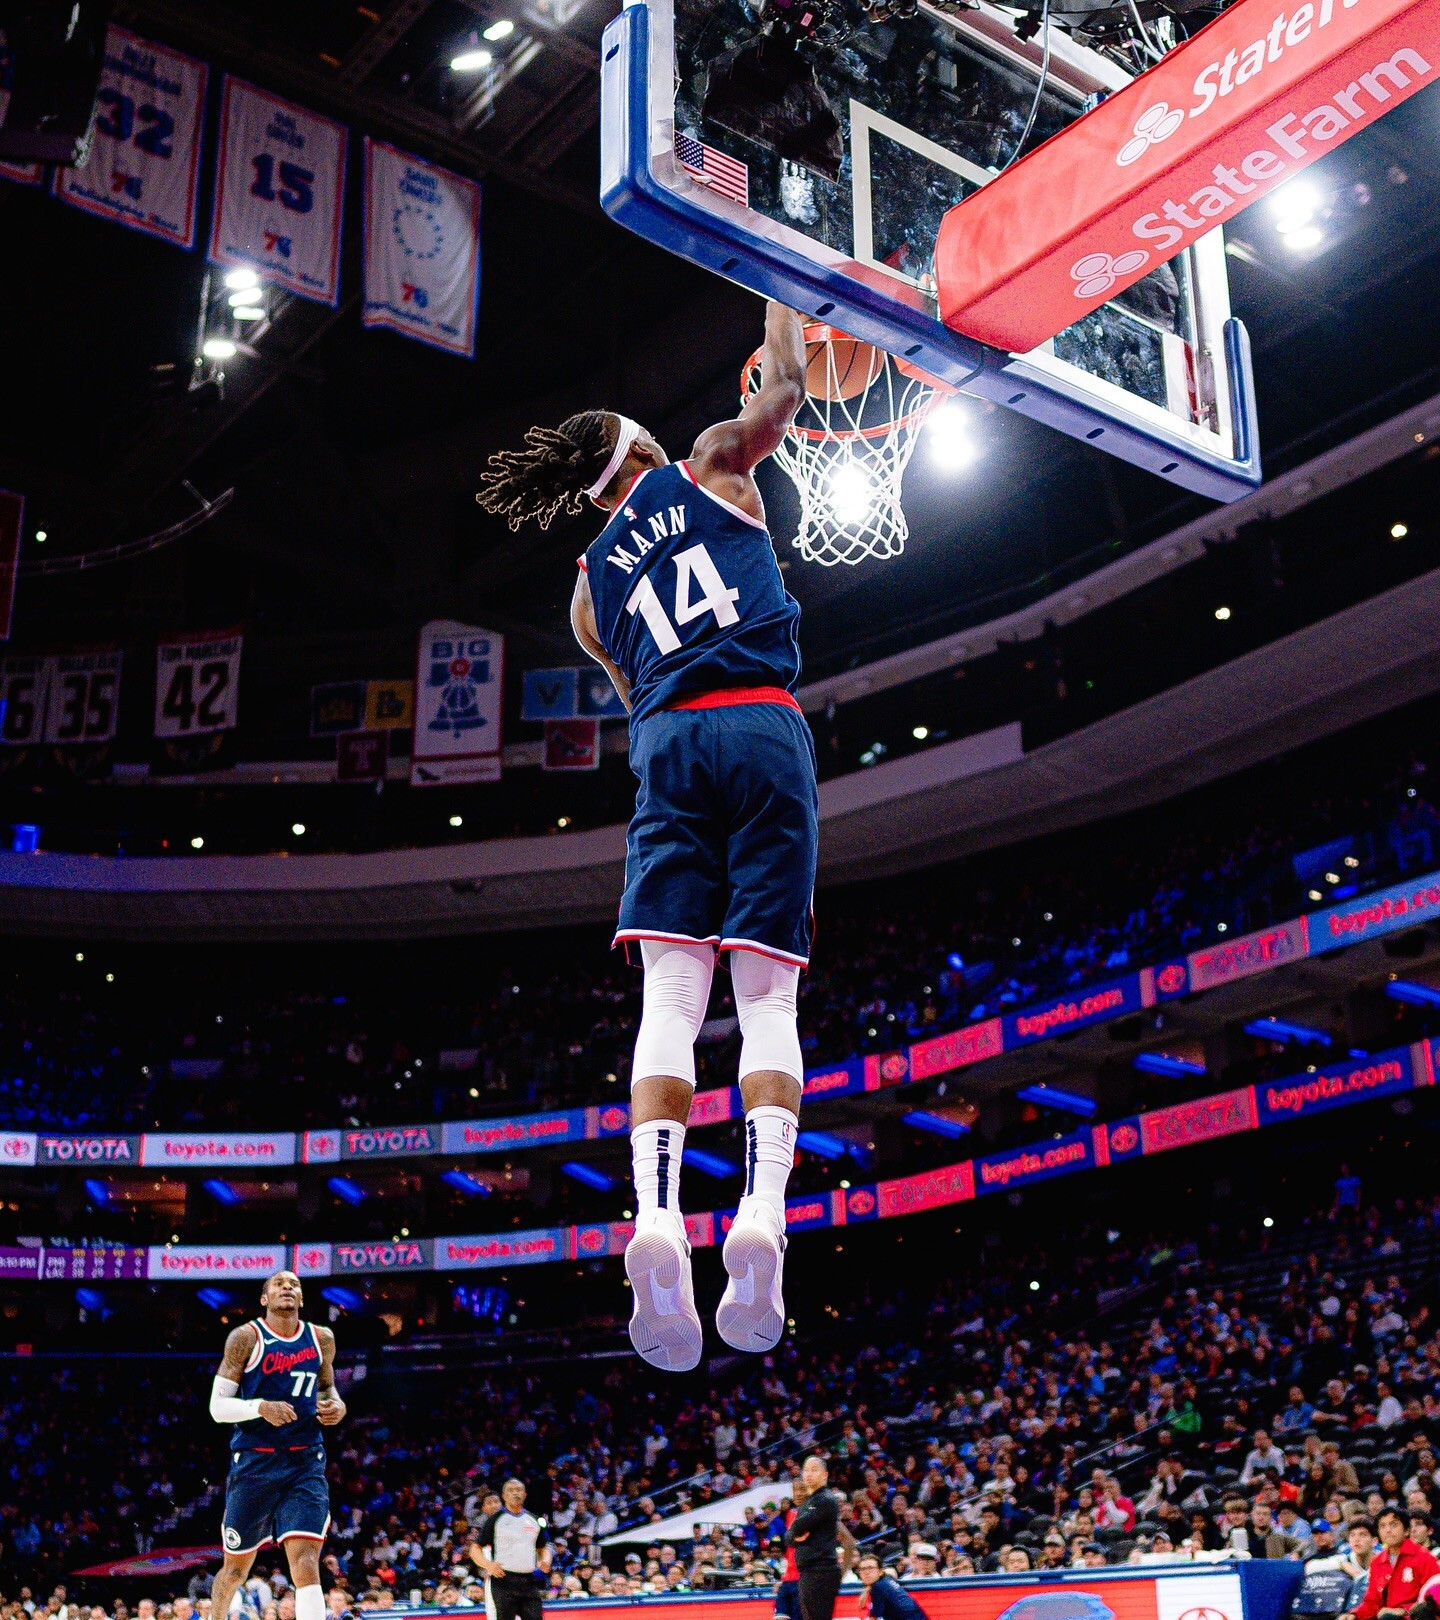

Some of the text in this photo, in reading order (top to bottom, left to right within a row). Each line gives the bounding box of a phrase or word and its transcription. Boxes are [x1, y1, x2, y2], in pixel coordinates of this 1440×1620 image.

[97, 87, 175, 158] 32
[112, 171, 143, 199] 76
[249, 153, 315, 214] 15
[263, 230, 292, 257] 76
[401, 282, 429, 308] 76
[606, 505, 686, 574] MANN
[625, 542, 740, 655] 14
[431, 640, 490, 659] BIG
[57, 674, 116, 738] 35
[162, 661, 230, 730] 42
[1016, 988, 1123, 1036] toyota.com
[1266, 1061, 1402, 1112] toyota.com
[43, 1119, 568, 1160] TOYOTA toyota.com TOYOTA toyota.com
[981, 1142, 1085, 1185] toyota.com
[161, 1252, 276, 1273] toyota.com
[337, 1244, 424, 1267] TOYOTA
[447, 1237, 554, 1263] toyota.com
[261, 1346, 318, 1375] Clippers
[290, 1371, 317, 1398] 77
